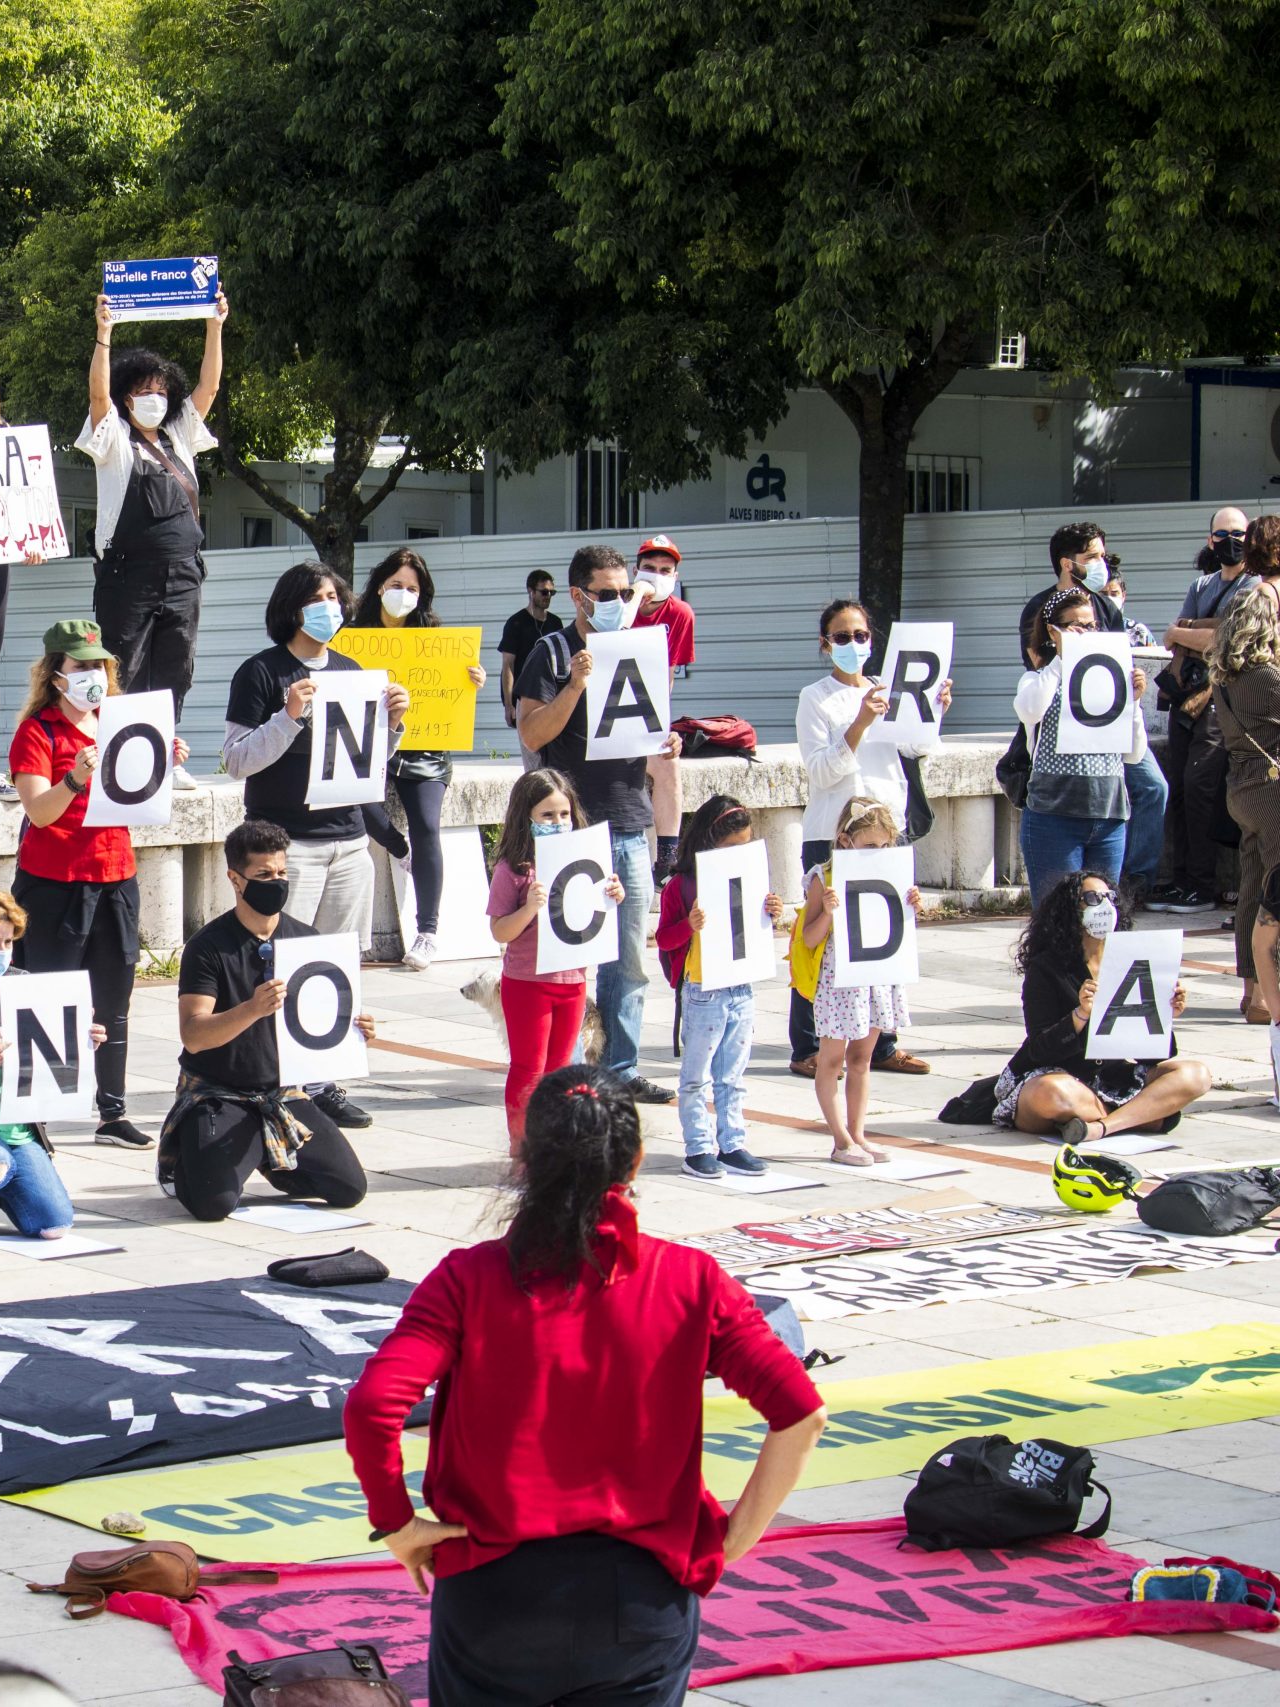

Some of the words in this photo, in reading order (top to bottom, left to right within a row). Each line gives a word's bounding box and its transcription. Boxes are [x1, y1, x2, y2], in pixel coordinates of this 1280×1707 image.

[105, 262, 126, 272] Rua
[106, 271, 148, 283] Marielle
[151, 270, 187, 281] Franco
[729, 507, 752, 520] ALVES
[408, 667, 442, 686] FOOD
[414, 636, 475, 659] DEATHS
[594, 657, 664, 739] A
[884, 650, 941, 724] R
[1068, 652, 1128, 728] O
[100, 722, 168, 806] O
[321, 700, 378, 781] N
[547, 858, 607, 947] C
[729, 876, 747, 961] I
[845, 879, 904, 963] D
[283, 960, 353, 1050] O
[1095, 959, 1164, 1036] A
[15, 1004, 80, 1098] N
[739, 1227, 1171, 1293] COLETIVO
[1070, 1358, 1199, 1382] CASA
